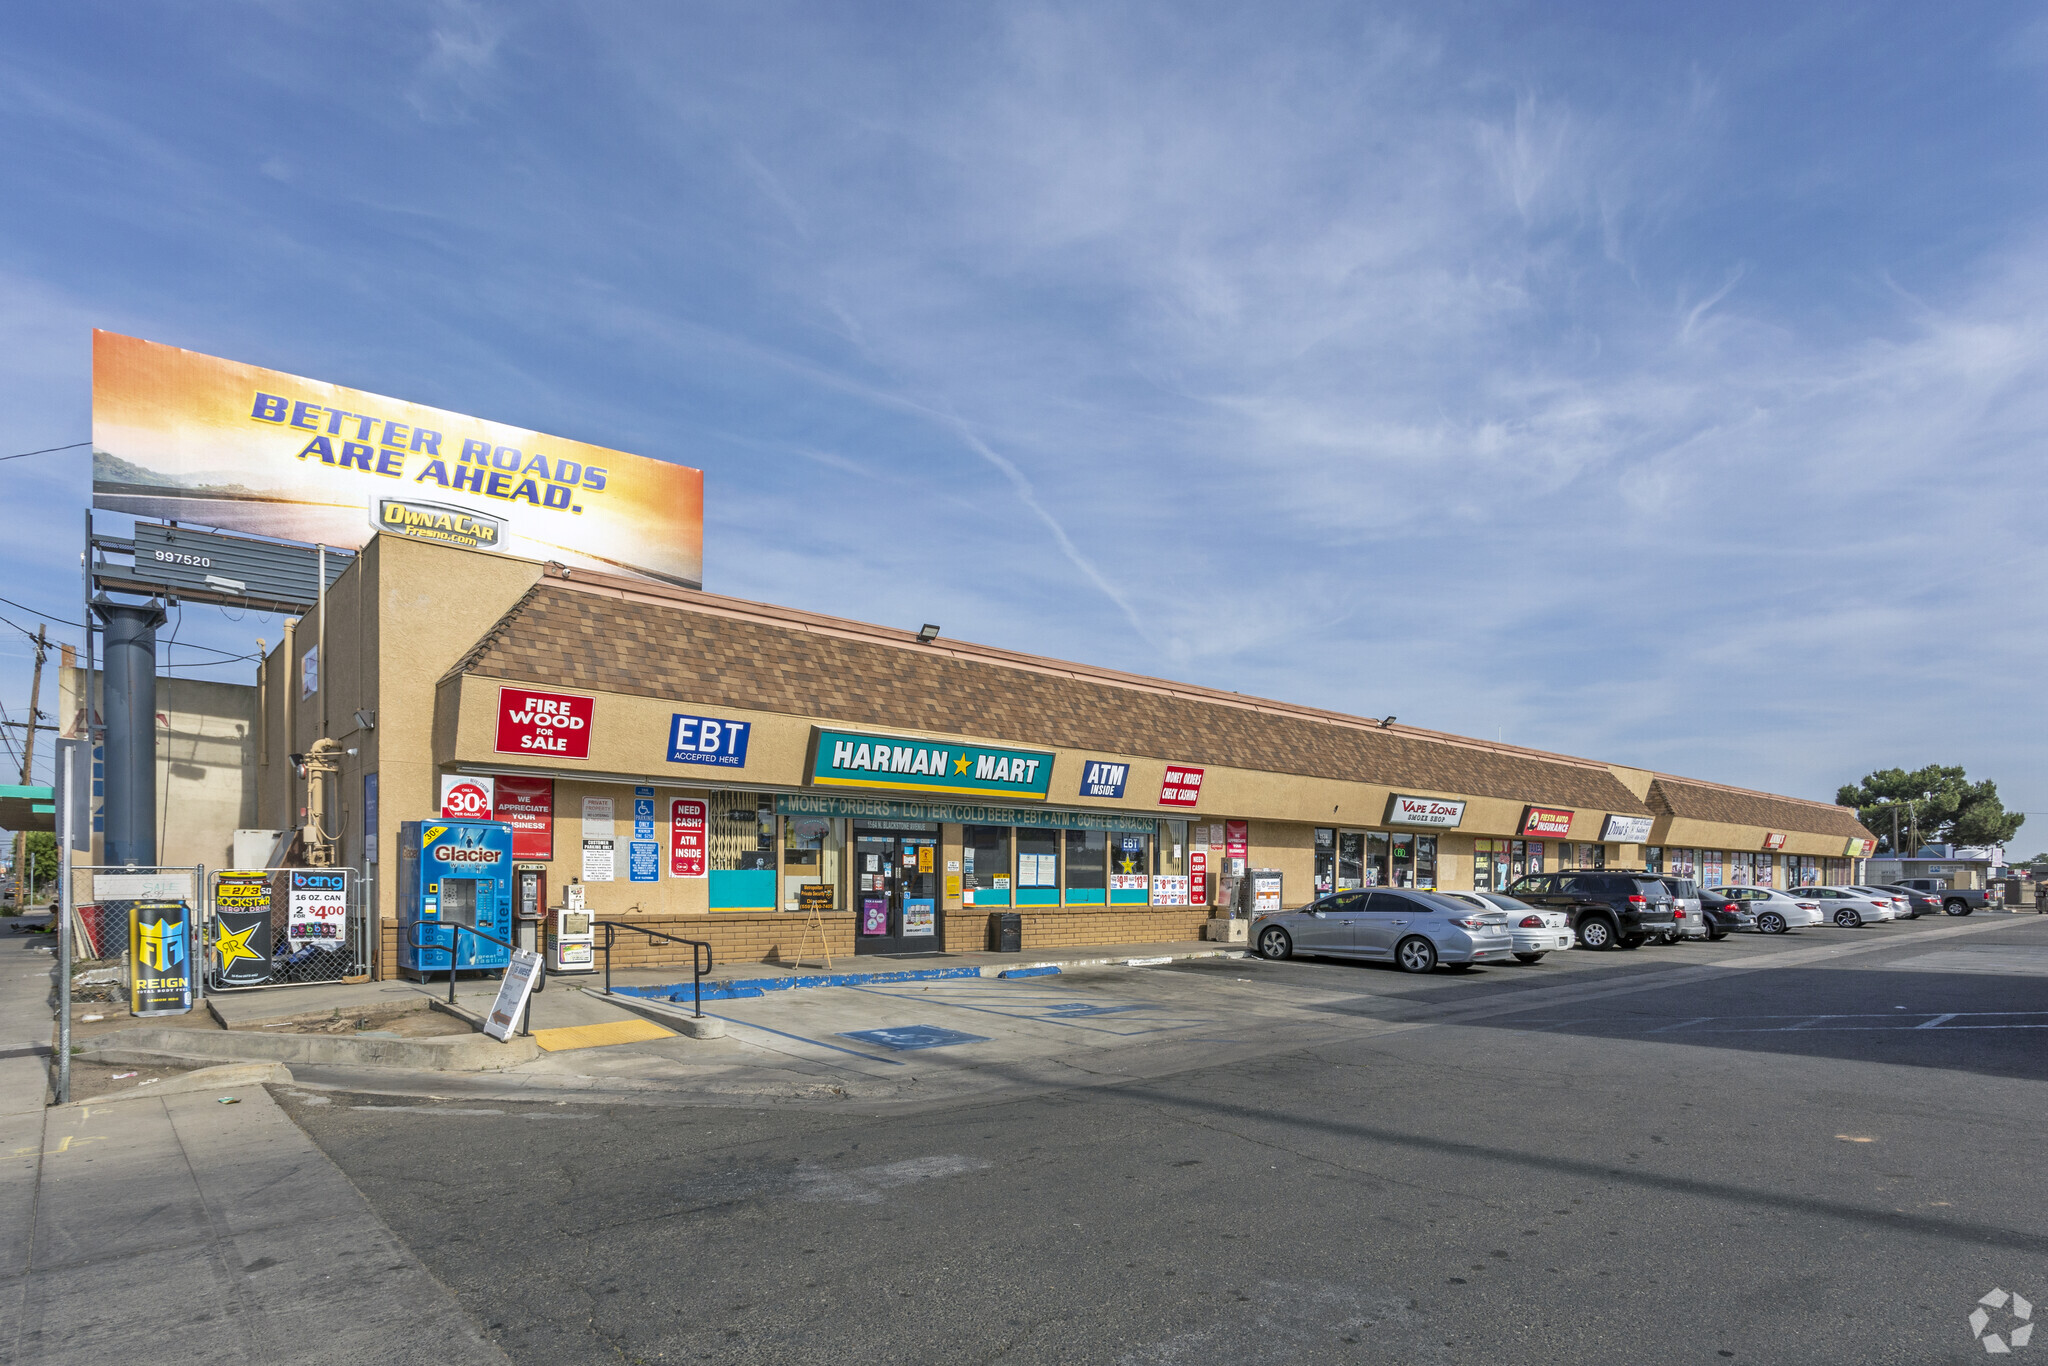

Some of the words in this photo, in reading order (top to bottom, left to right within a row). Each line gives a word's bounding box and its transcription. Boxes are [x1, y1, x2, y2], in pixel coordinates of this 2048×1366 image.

[250, 391, 443, 457] BETTER
[460, 437, 609, 492] ROADS
[297, 434, 405, 478] ARE
[415, 459, 583, 515] AHEAD.
[405, 524, 477, 547] Fresno.com
[155, 550, 210, 568] 997520
[525, 697, 571, 716] FIRE
[508, 709, 585, 730] WOOD
[536, 727, 553, 736] FOR
[676, 717, 744, 755] EBT
[520, 735, 568, 751] SALE
[674, 752, 717, 763] ACCEPTED
[718, 755, 739, 765] HERE
[832, 740, 949, 777] HARMAN
[975, 754, 1040, 784] MART
[1087, 763, 1125, 786] ATM
[1165, 771, 1184, 784] MONEY
[1183, 773, 1202, 785] ORDERS
[1090, 784, 1115, 796] INSIDE
[1161, 787, 1178, 800] CHECK
[1177, 788, 1198, 801] CASHING
[448, 792, 487, 812] 30¢
[498, 804, 549, 813] APPRECIATE
[1402, 799, 1428, 814] VAPE
[1428, 803, 1458, 816] ZONE
[678, 805, 700, 815] NEED
[788, 795, 836, 813] MONEY
[839, 799, 890, 816] ORDERS
[903, 803, 954, 819] LOTTERY
[955, 806, 984, 822] COLD
[987, 807, 1015, 823] BEER
[1024, 810, 1044, 824] EBT
[1051, 811, 1070, 826] ATM
[1077, 814, 1113, 828] COFFEE
[1120, 815, 1154, 831] SNACKS
[512, 813, 535, 821] YOUR
[675, 817, 702, 828] CASH?
[1408, 814, 1428, 822] SMOKE
[1430, 815, 1446, 823] SHOP
[1540, 813, 1556, 821] FIESTA
[1556, 815, 1569, 823] AUTO
[883, 821, 910, 830] BLACKSTONE
[910, 823, 926, 831] AVENUE
[1537, 821, 1570, 833] INSURANCE
[680, 836, 697, 846] ATM
[1123, 838, 1138, 848] EBT
[434, 845, 502, 863] Glacier
[675, 848, 702, 858] INSIDE
[142, 882, 180, 892] SALE
[293, 872, 344, 891] bang
[296, 905, 304, 914] 2
[136, 977, 189, 990] REIGN
